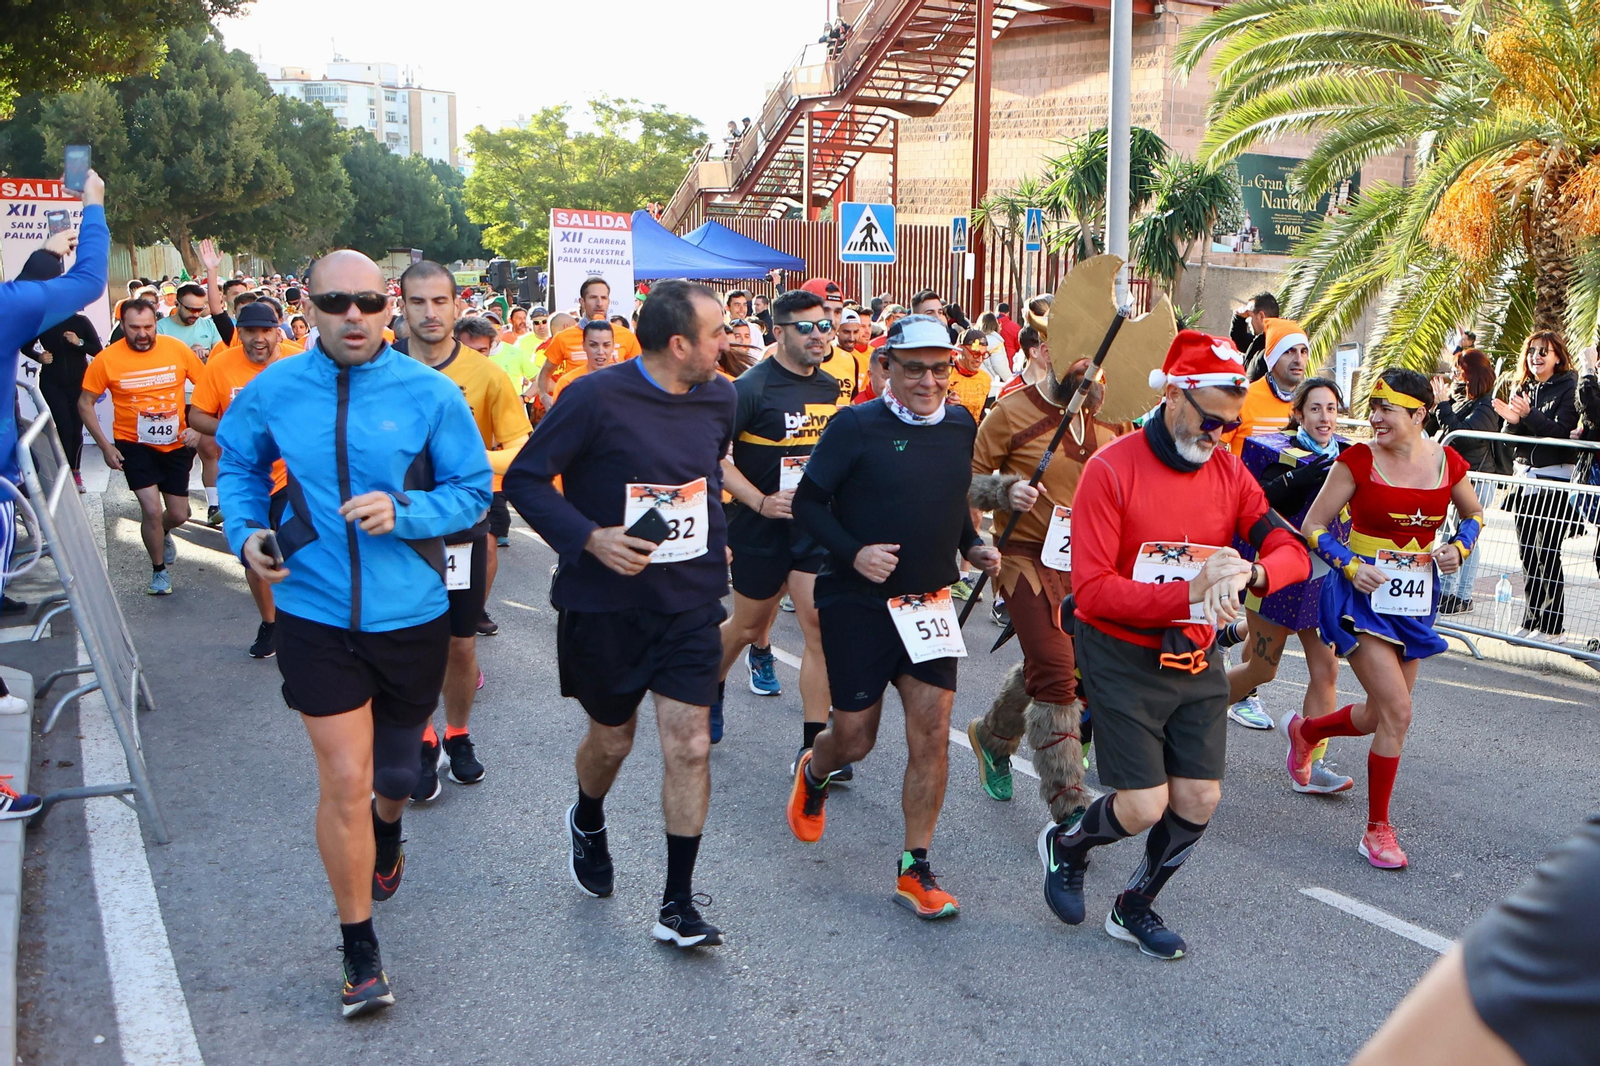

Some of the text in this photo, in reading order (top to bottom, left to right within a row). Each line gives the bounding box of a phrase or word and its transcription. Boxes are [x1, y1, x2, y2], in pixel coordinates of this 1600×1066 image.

[1240, 174, 1253, 187] La
[1254, 173, 1284, 191] Gran
[1, 182, 75, 198] SALI
[6, 203, 37, 217] XII
[556, 212, 628, 229] SALIDA
[4, 231, 43, 240] PALMA
[1274, 224, 1301, 236] 3.000
[560, 231, 626, 245] XII CARRERA
[583, 248, 625, 256] SILVESTRE
[589, 257, 631, 265] PALMILLA
[784, 411, 834, 429] bicho
[147, 425, 173, 436] 448
[785, 428, 824, 439] runne
[666, 516, 695, 541] 32
[1389, 578, 1425, 598] 844
[915, 617, 950, 641] 519
